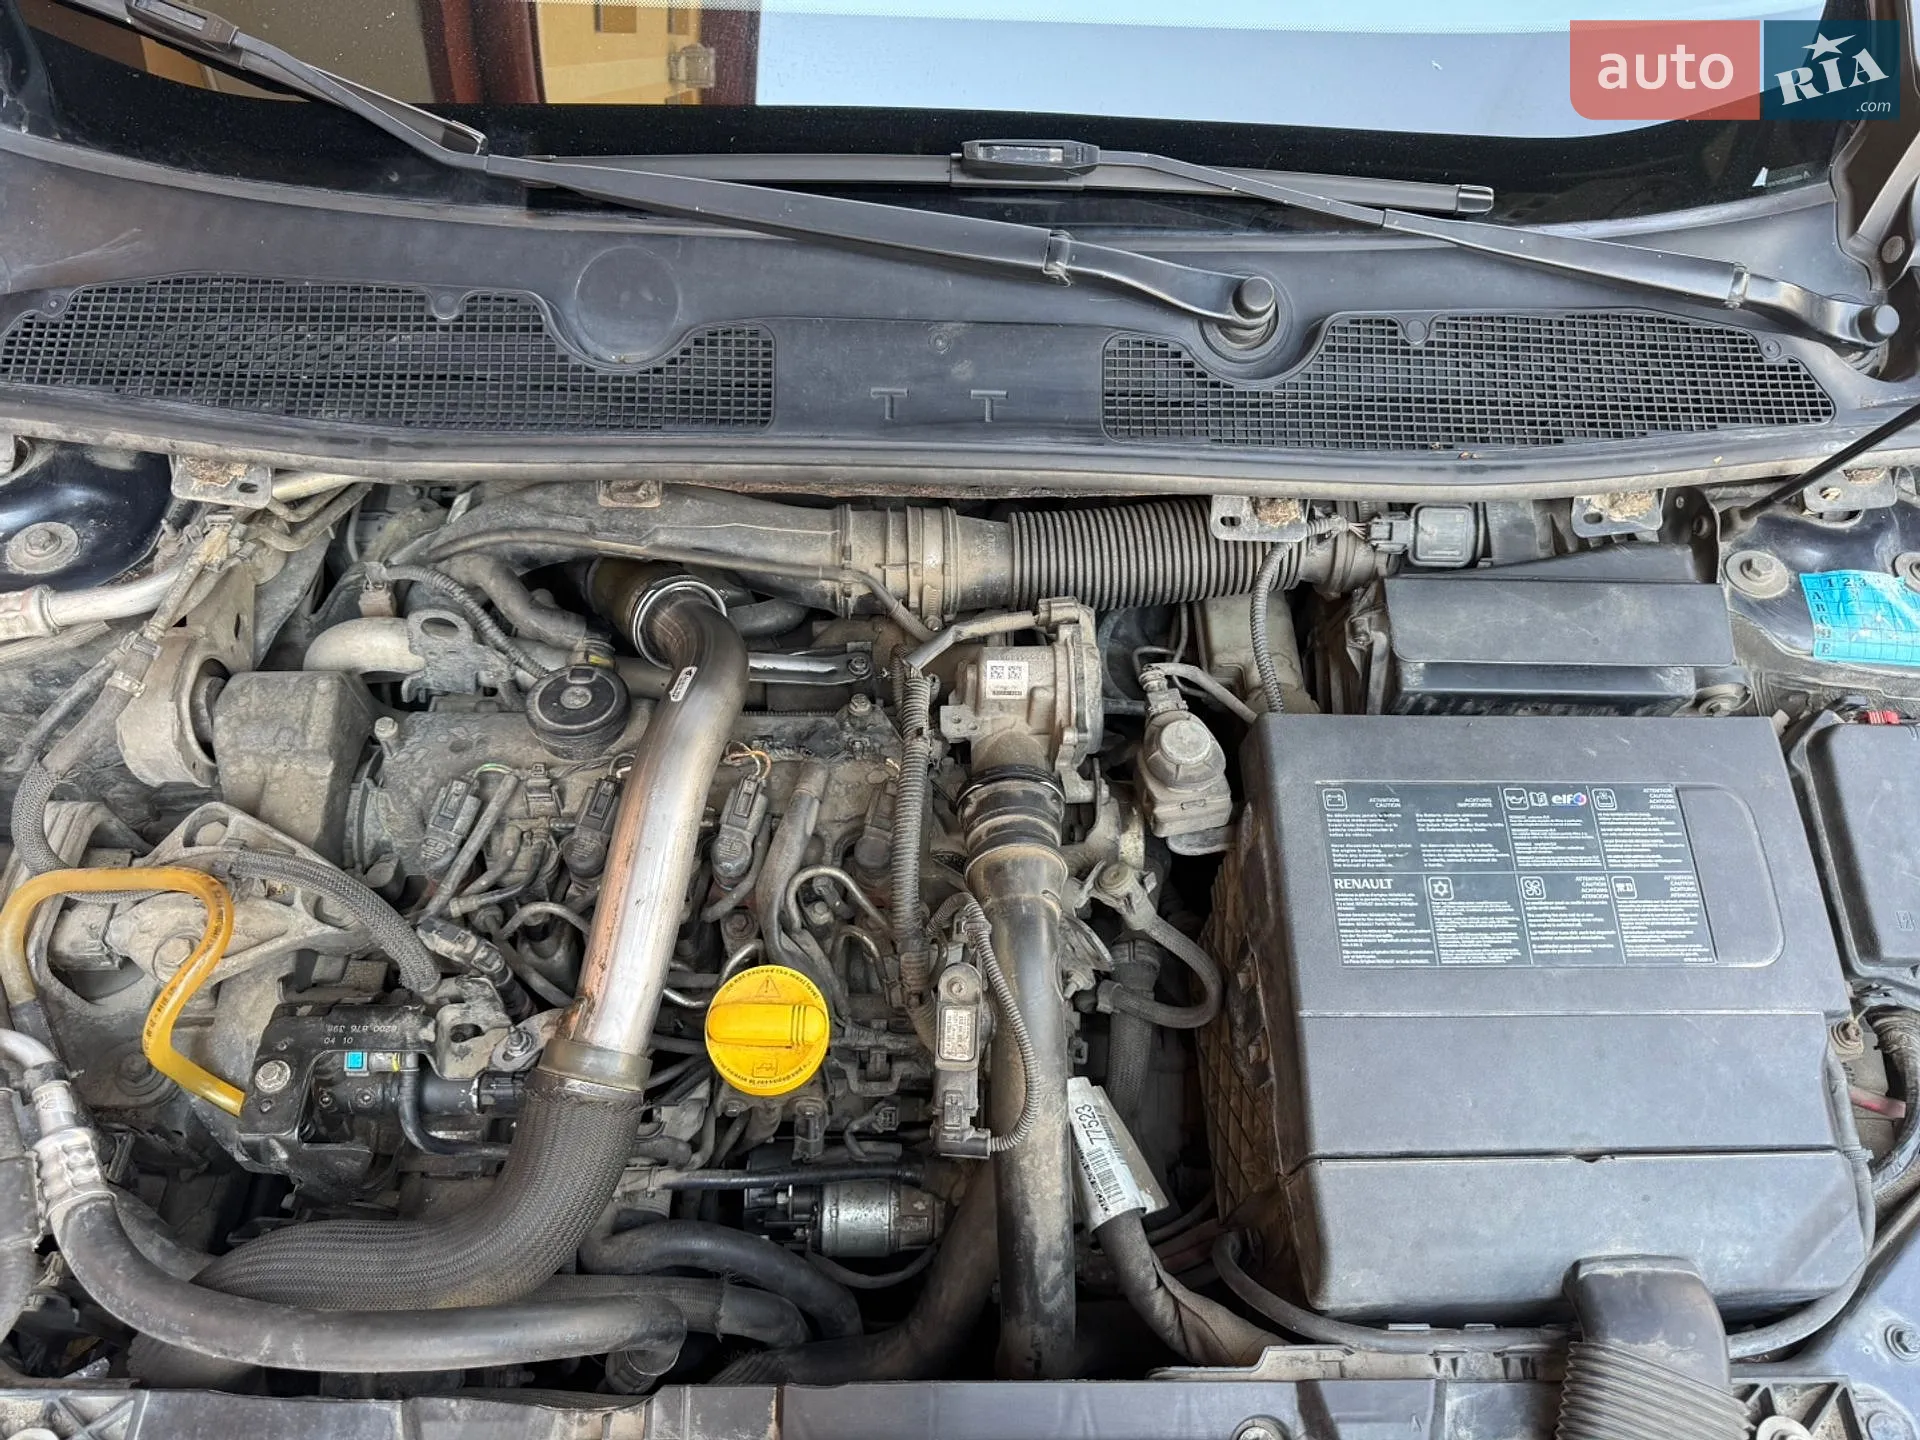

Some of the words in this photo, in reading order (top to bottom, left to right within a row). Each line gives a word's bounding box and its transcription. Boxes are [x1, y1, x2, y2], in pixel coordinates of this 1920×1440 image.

[1826, 578, 1834, 588] 1
[1842, 577, 1852, 587] 2
[1812, 591, 1822, 600] A
[1819, 615, 1829, 625] C
[1821, 643, 1831, 654] E
[1552, 793, 1575, 806] elf
[1334, 878, 1393, 890] RENAULT
[1074, 1103, 1107, 1145] 77523
